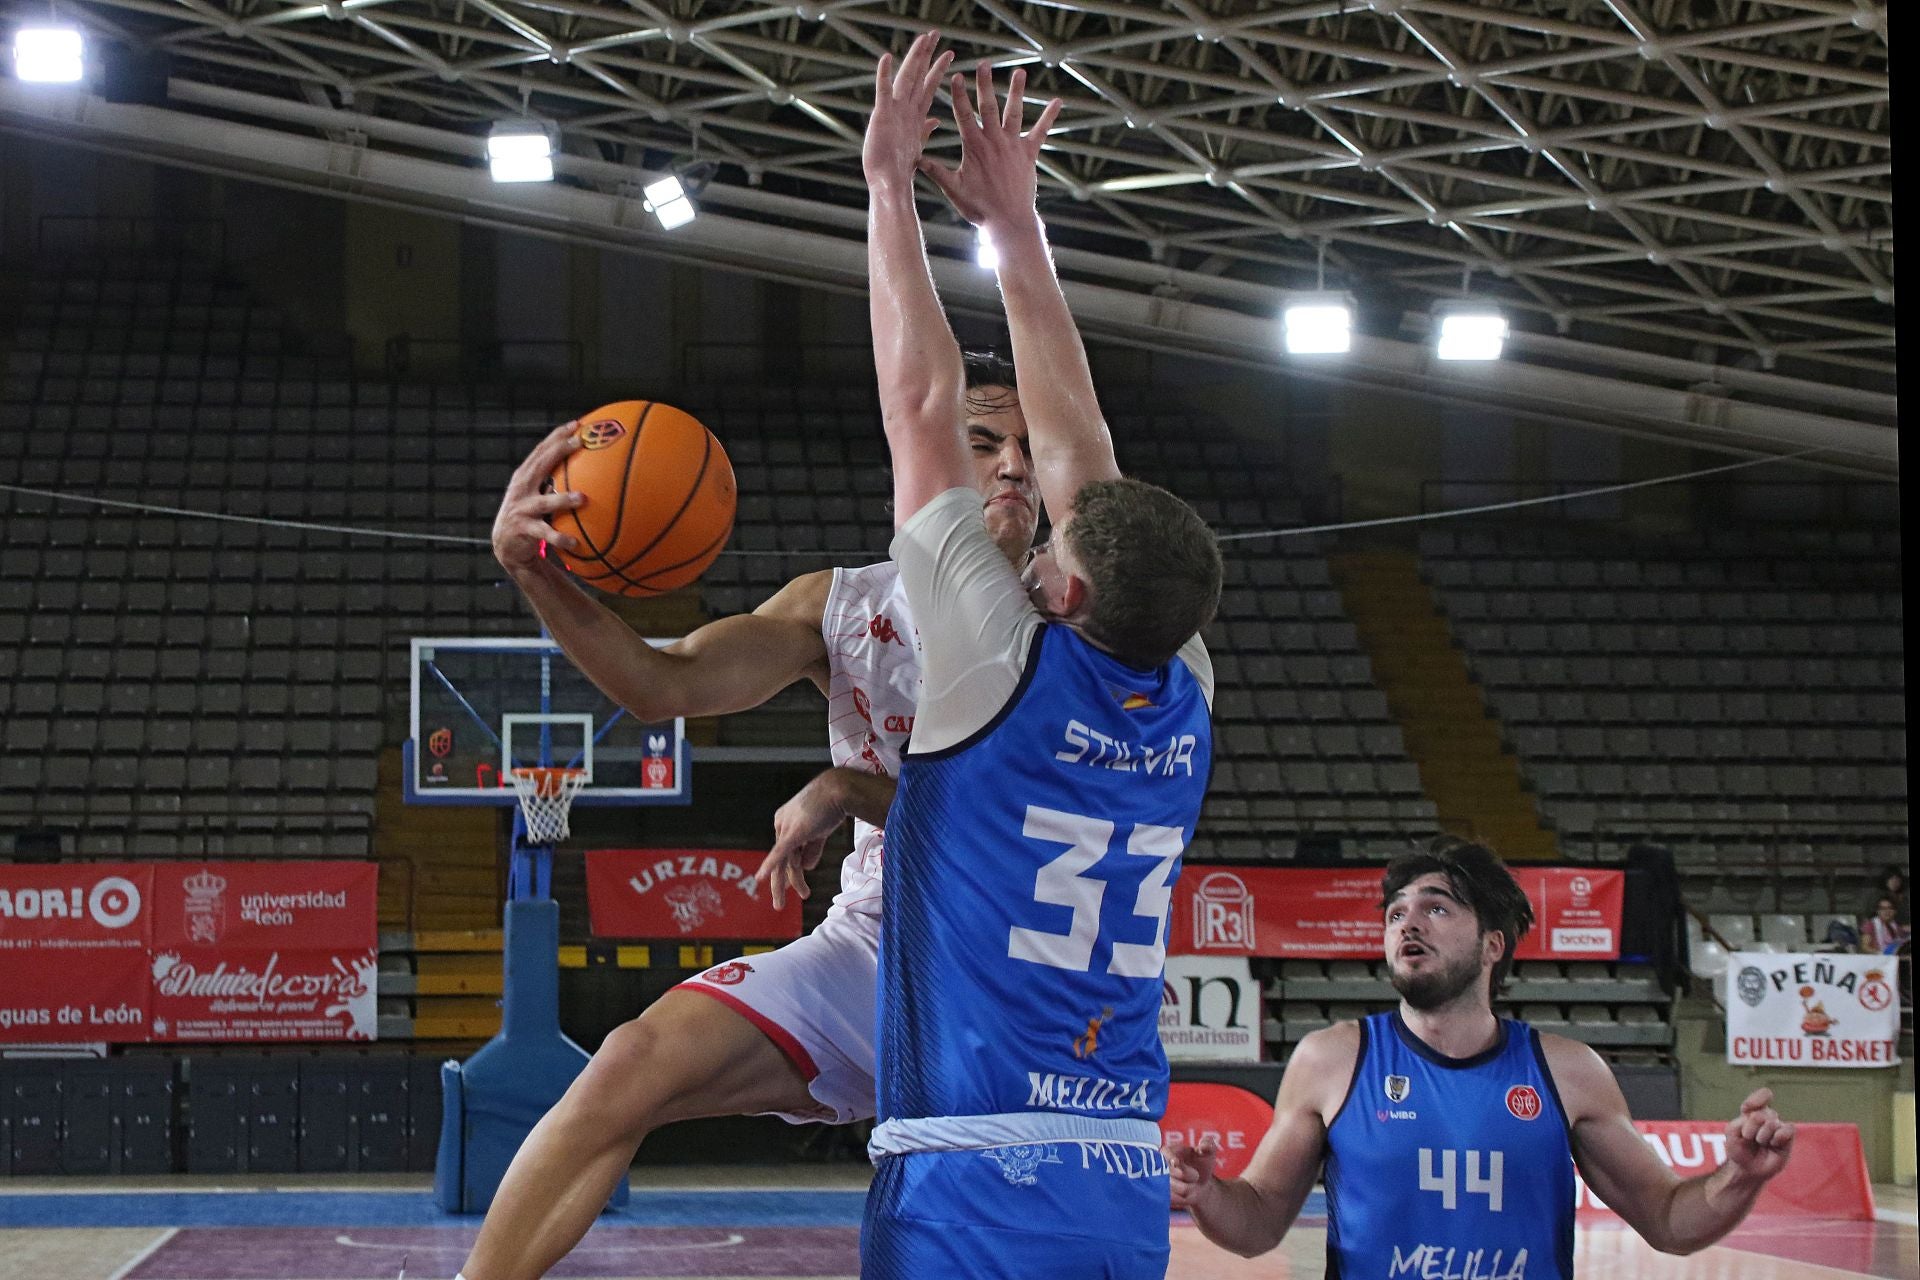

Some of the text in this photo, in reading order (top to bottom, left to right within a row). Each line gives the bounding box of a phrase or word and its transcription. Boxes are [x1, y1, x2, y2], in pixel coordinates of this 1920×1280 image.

[1055, 717, 1196, 777] STILMA
[240, 890, 346, 909] universidad
[1008, 804, 1185, 979] 33
[1206, 902, 1242, 943] R3
[1769, 957, 1858, 995] PEÑA
[56, 1004, 83, 1025] de
[89, 1002, 143, 1025] León
[1734, 1037, 1895, 1063] CULTU BASKET
[1025, 1071, 1151, 1113] MELILLA
[1389, 1110, 1417, 1121] WIBO
[1418, 1147, 1504, 1213] 44
[1388, 1243, 1529, 1280] MELILLA
